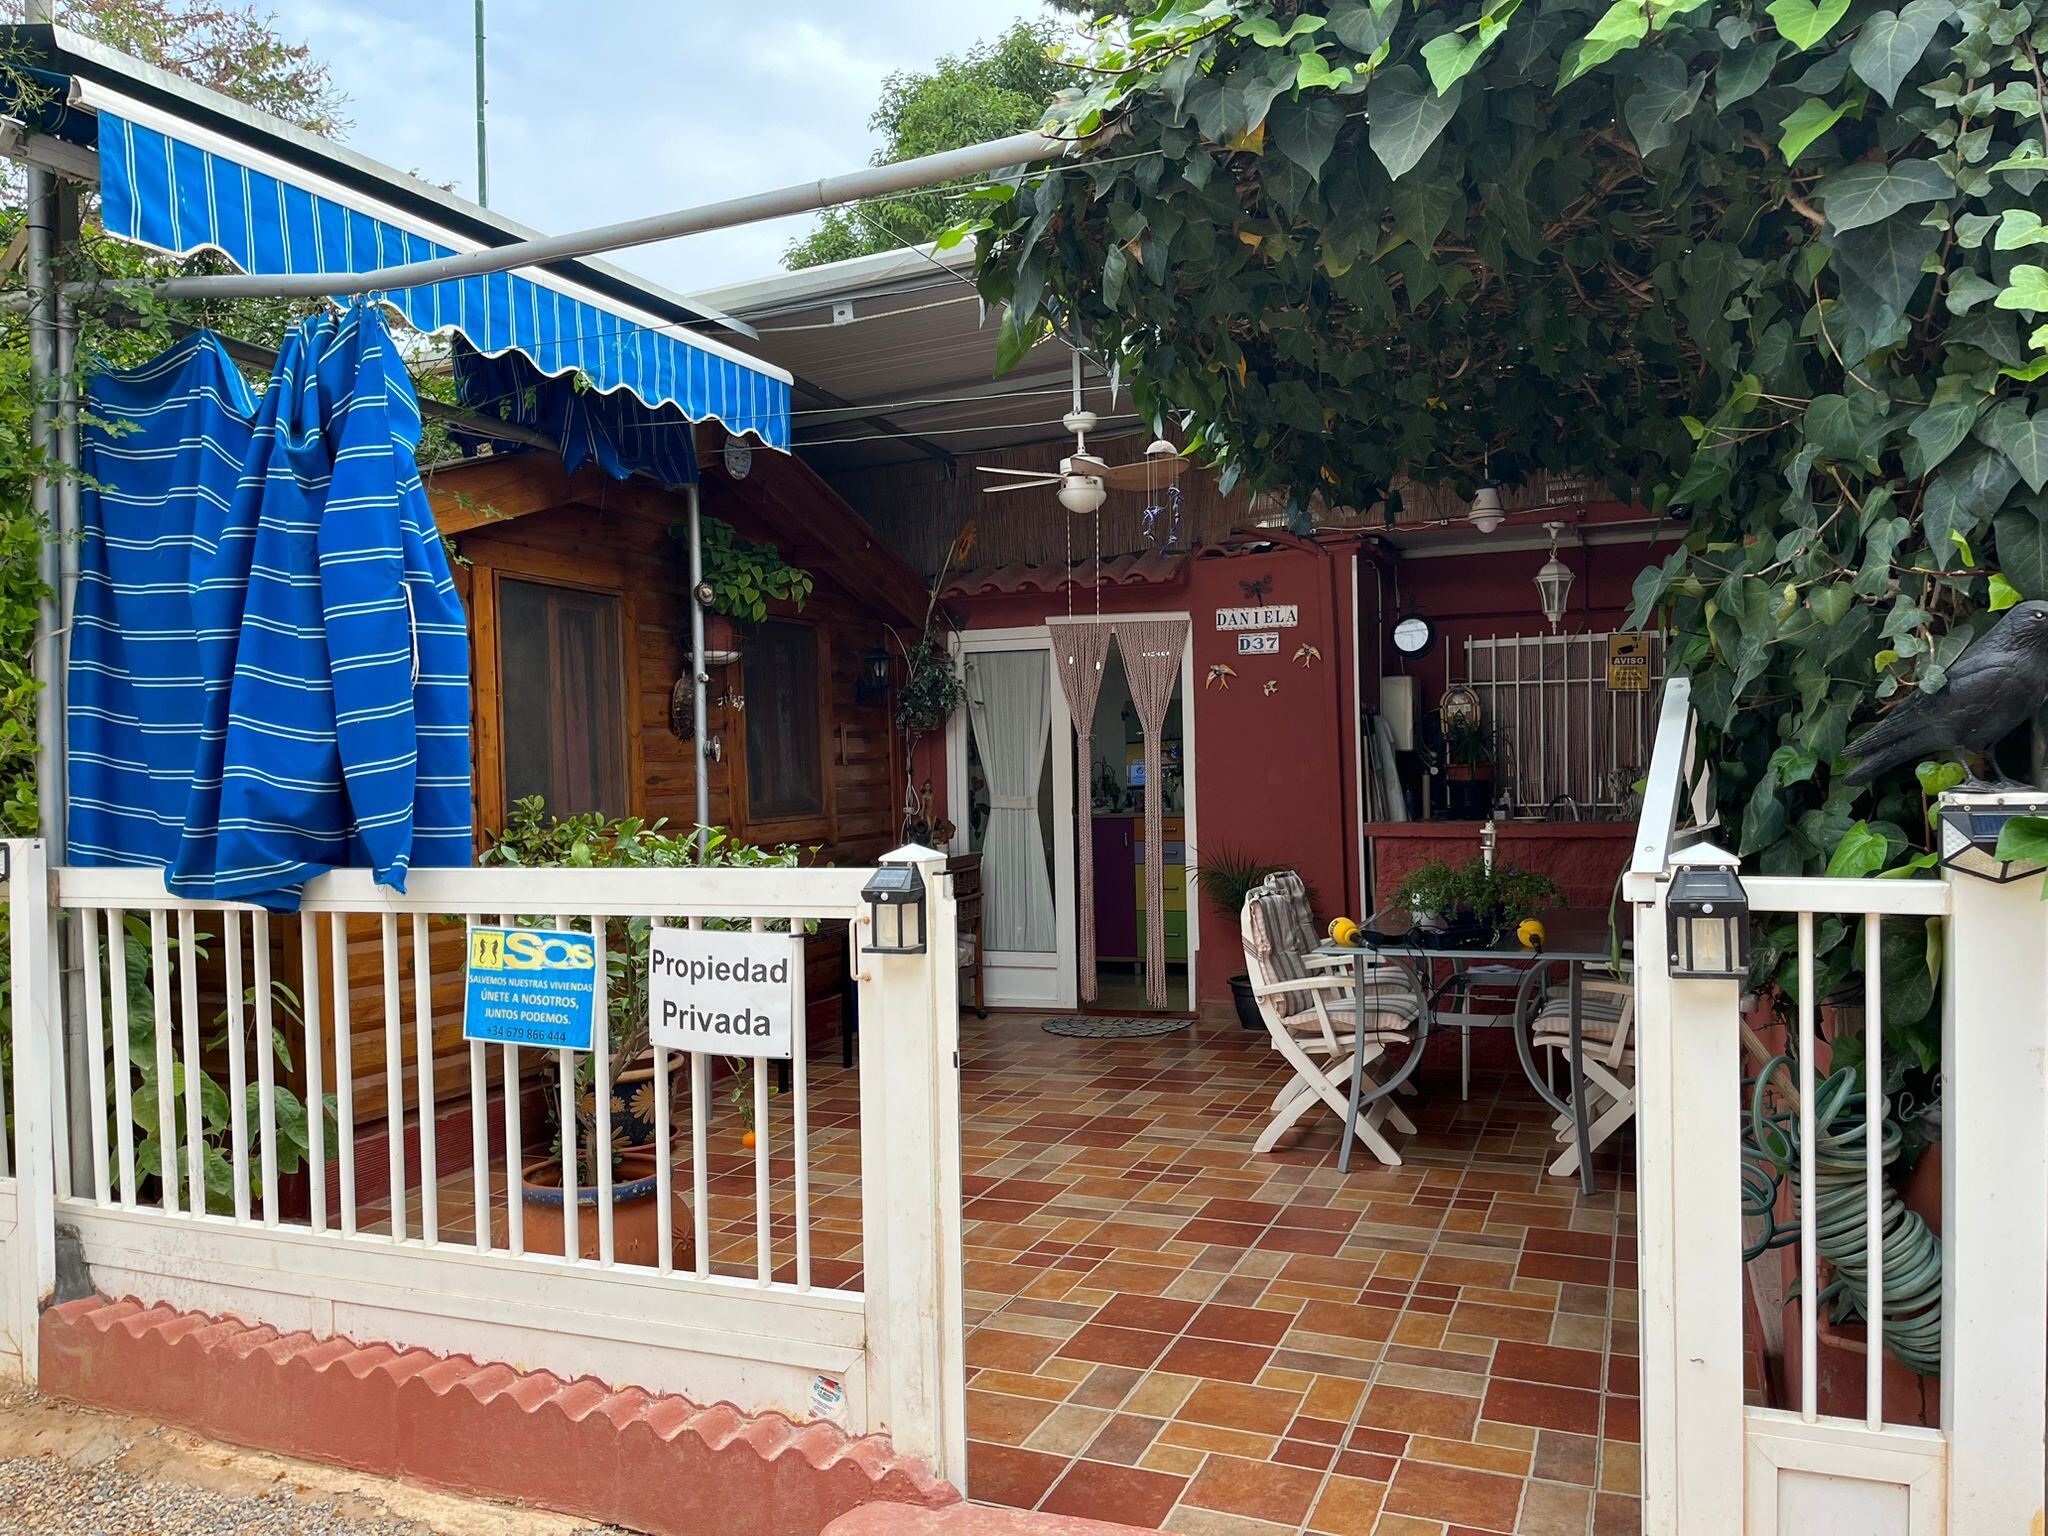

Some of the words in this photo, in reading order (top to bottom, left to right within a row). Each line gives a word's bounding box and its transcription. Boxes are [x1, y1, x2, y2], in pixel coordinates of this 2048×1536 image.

[1217, 610, 1296, 626] DANIELA
[1239, 637, 1278, 651] D37
[652, 949, 788, 985] Propiedad
[469, 975, 507, 986] SALVEMOS
[509, 978, 548, 989] NUESTRAS
[550, 982, 593, 992] VIVIENDAS
[480, 988, 510, 1003] ÚNETE
[512, 995, 520, 1004] A
[521, 994, 580, 1010] NOSOTROS,
[484, 1008, 518, 1021] JUNTOS
[520, 1011, 572, 1025] PODEMOS.
[663, 1000, 771, 1036] Privada
[487, 1026, 504, 1036] +34
[506, 1027, 524, 1038] 679
[526, 1030, 545, 1040] 866
[547, 1032, 567, 1042] 444
